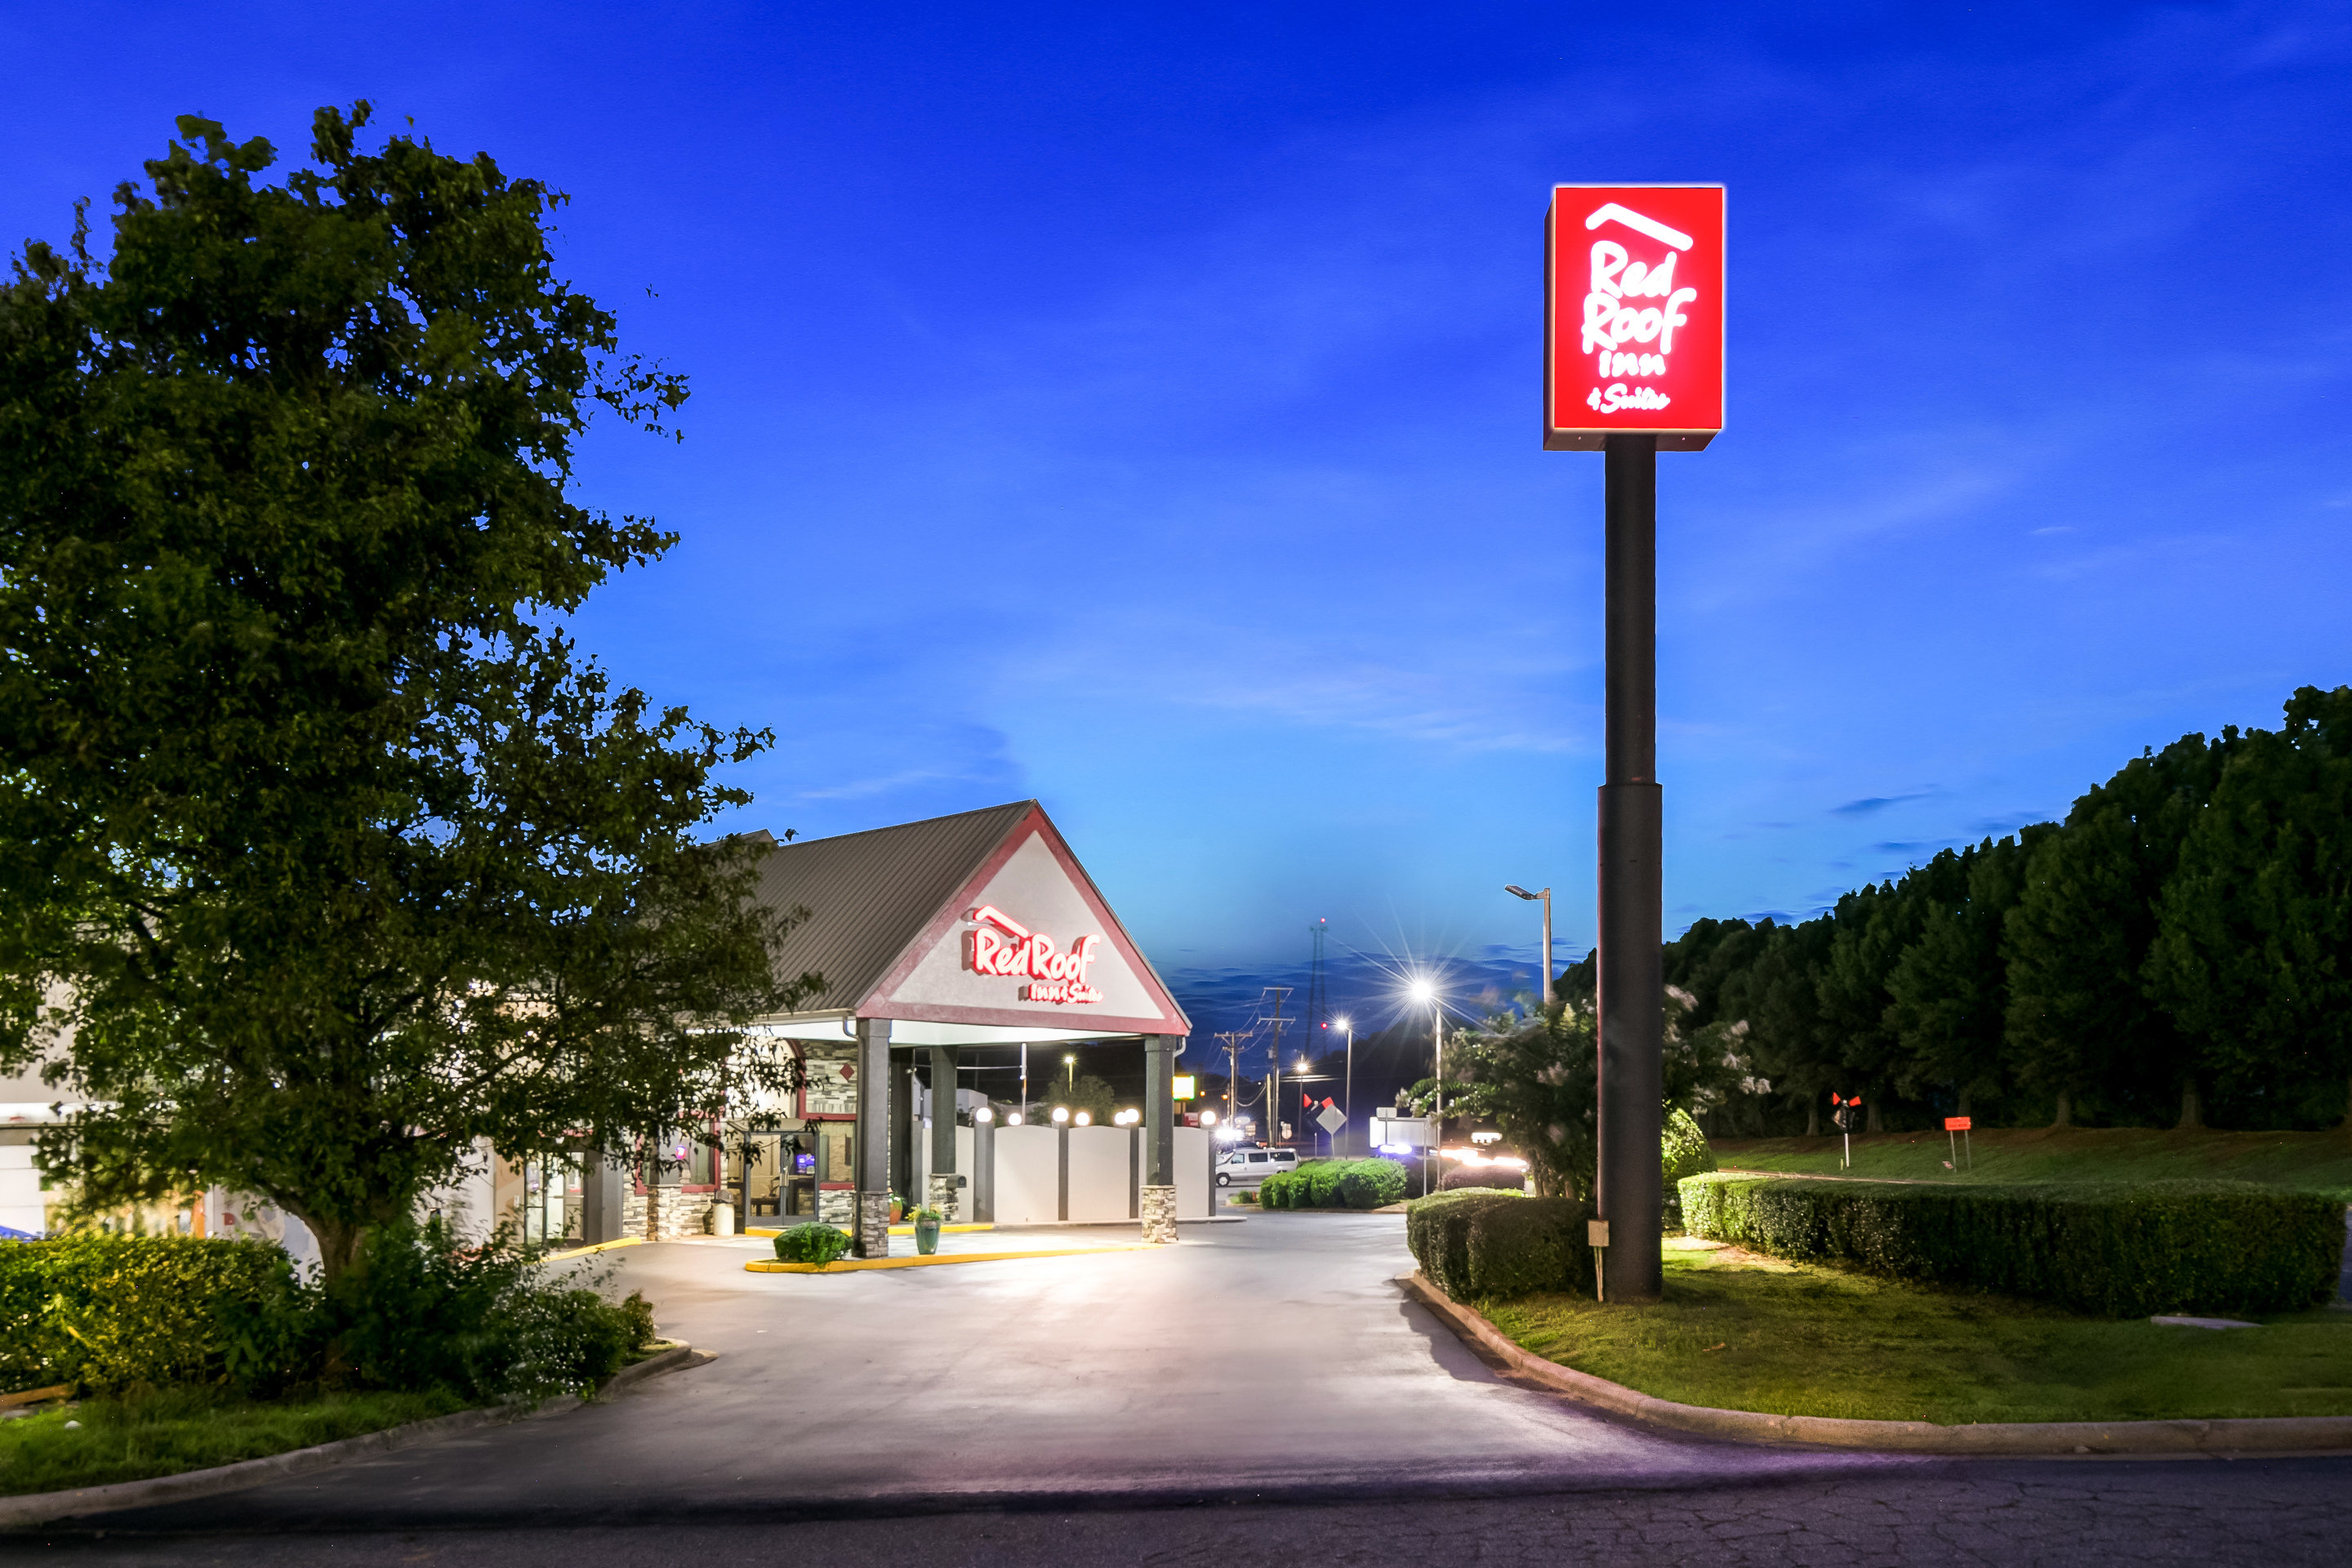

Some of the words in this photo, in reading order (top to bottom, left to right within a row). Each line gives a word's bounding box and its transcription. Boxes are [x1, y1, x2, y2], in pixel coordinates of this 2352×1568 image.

[1591, 240, 1677, 299] Red
[1581, 287, 1697, 354] Roof
[974, 928, 1031, 976] Red
[1031, 933, 1101, 983] Roof
[1030, 982, 1060, 1001] Inn
